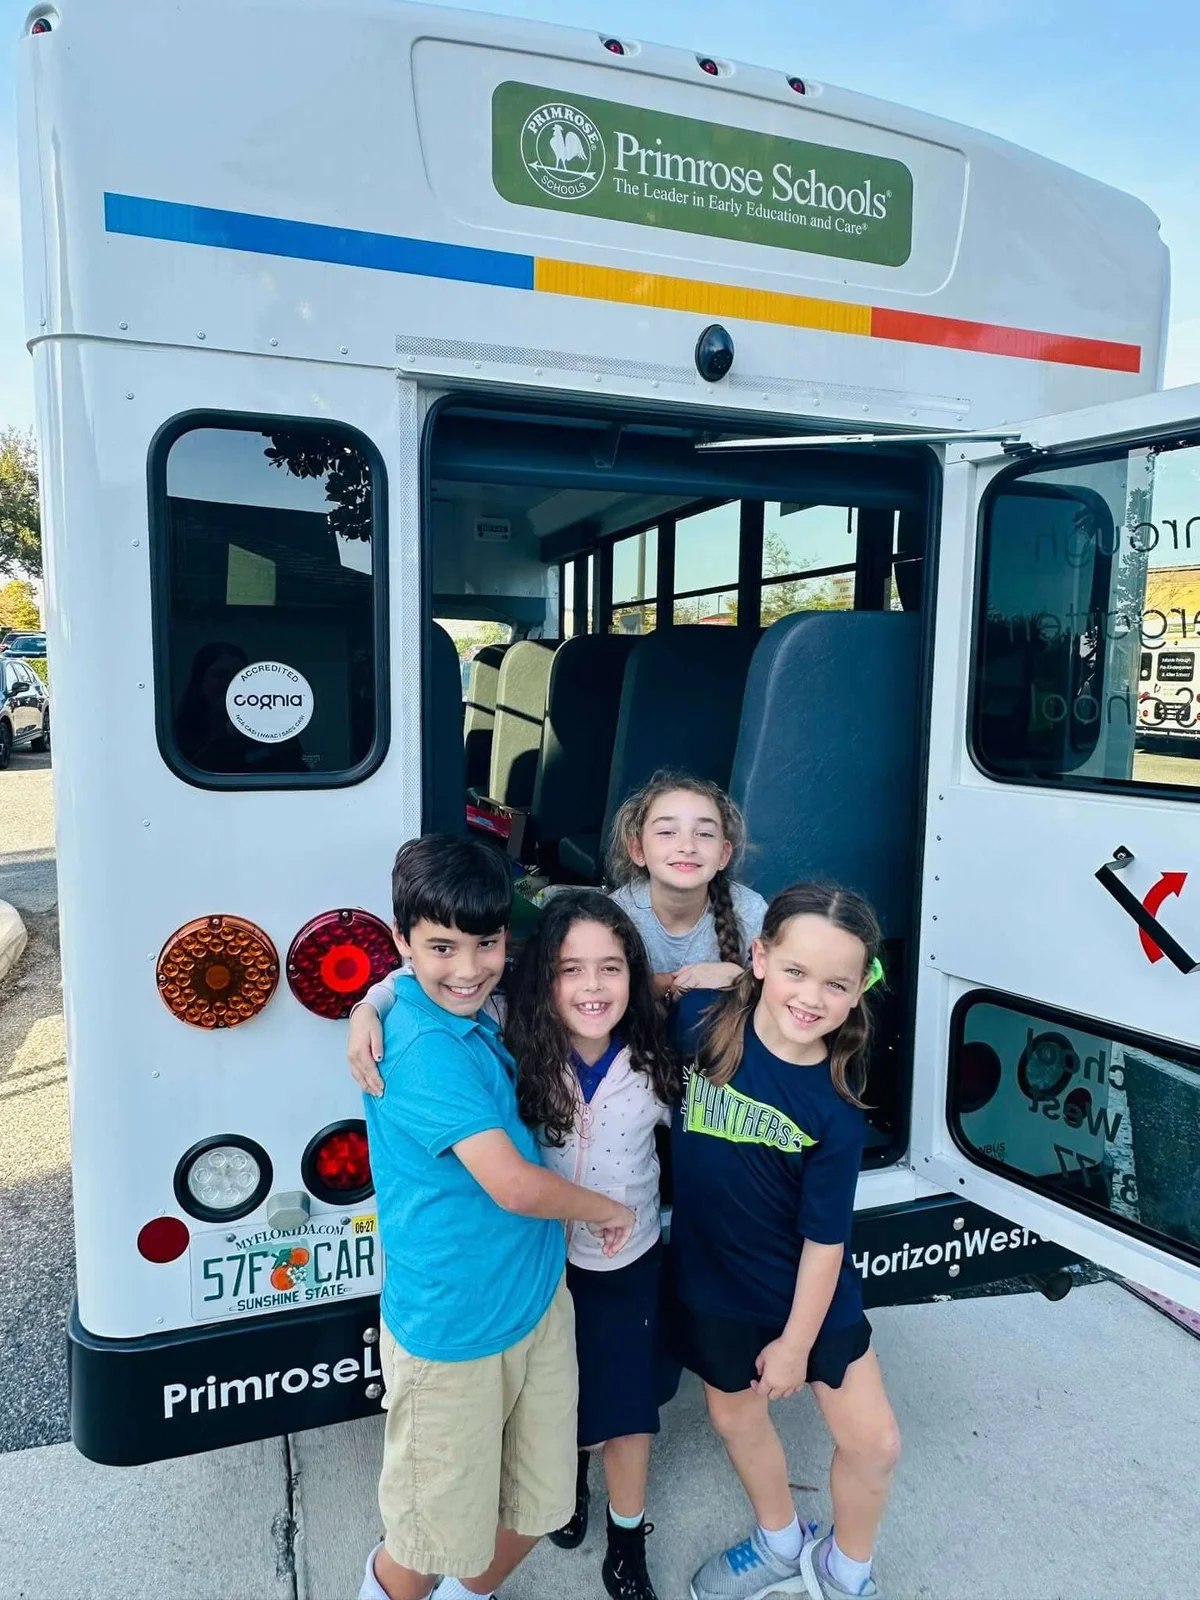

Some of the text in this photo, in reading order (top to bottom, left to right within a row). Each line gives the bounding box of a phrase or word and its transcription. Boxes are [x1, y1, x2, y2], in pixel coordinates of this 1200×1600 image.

[613, 131, 763, 196] Primrose
[541, 175, 587, 195] SCHOOLS
[613, 177, 640, 196] The
[643, 182, 689, 204] Leader
[692, 191, 704, 207] in
[709, 194, 742, 217] Early
[746, 201, 807, 226] Education
[810, 215, 831, 230] and
[240, 664, 299, 683] ACCREDITED
[234, 694, 303, 710] cognia
[691, 1071, 795, 1149] PANTHERS
[235, 1219, 375, 1251] MYFLORIDA.COM 06-27
[203, 1235, 375, 1302] 57F CAR
[236, 1283, 346, 1312] SUNSHINE STATE
